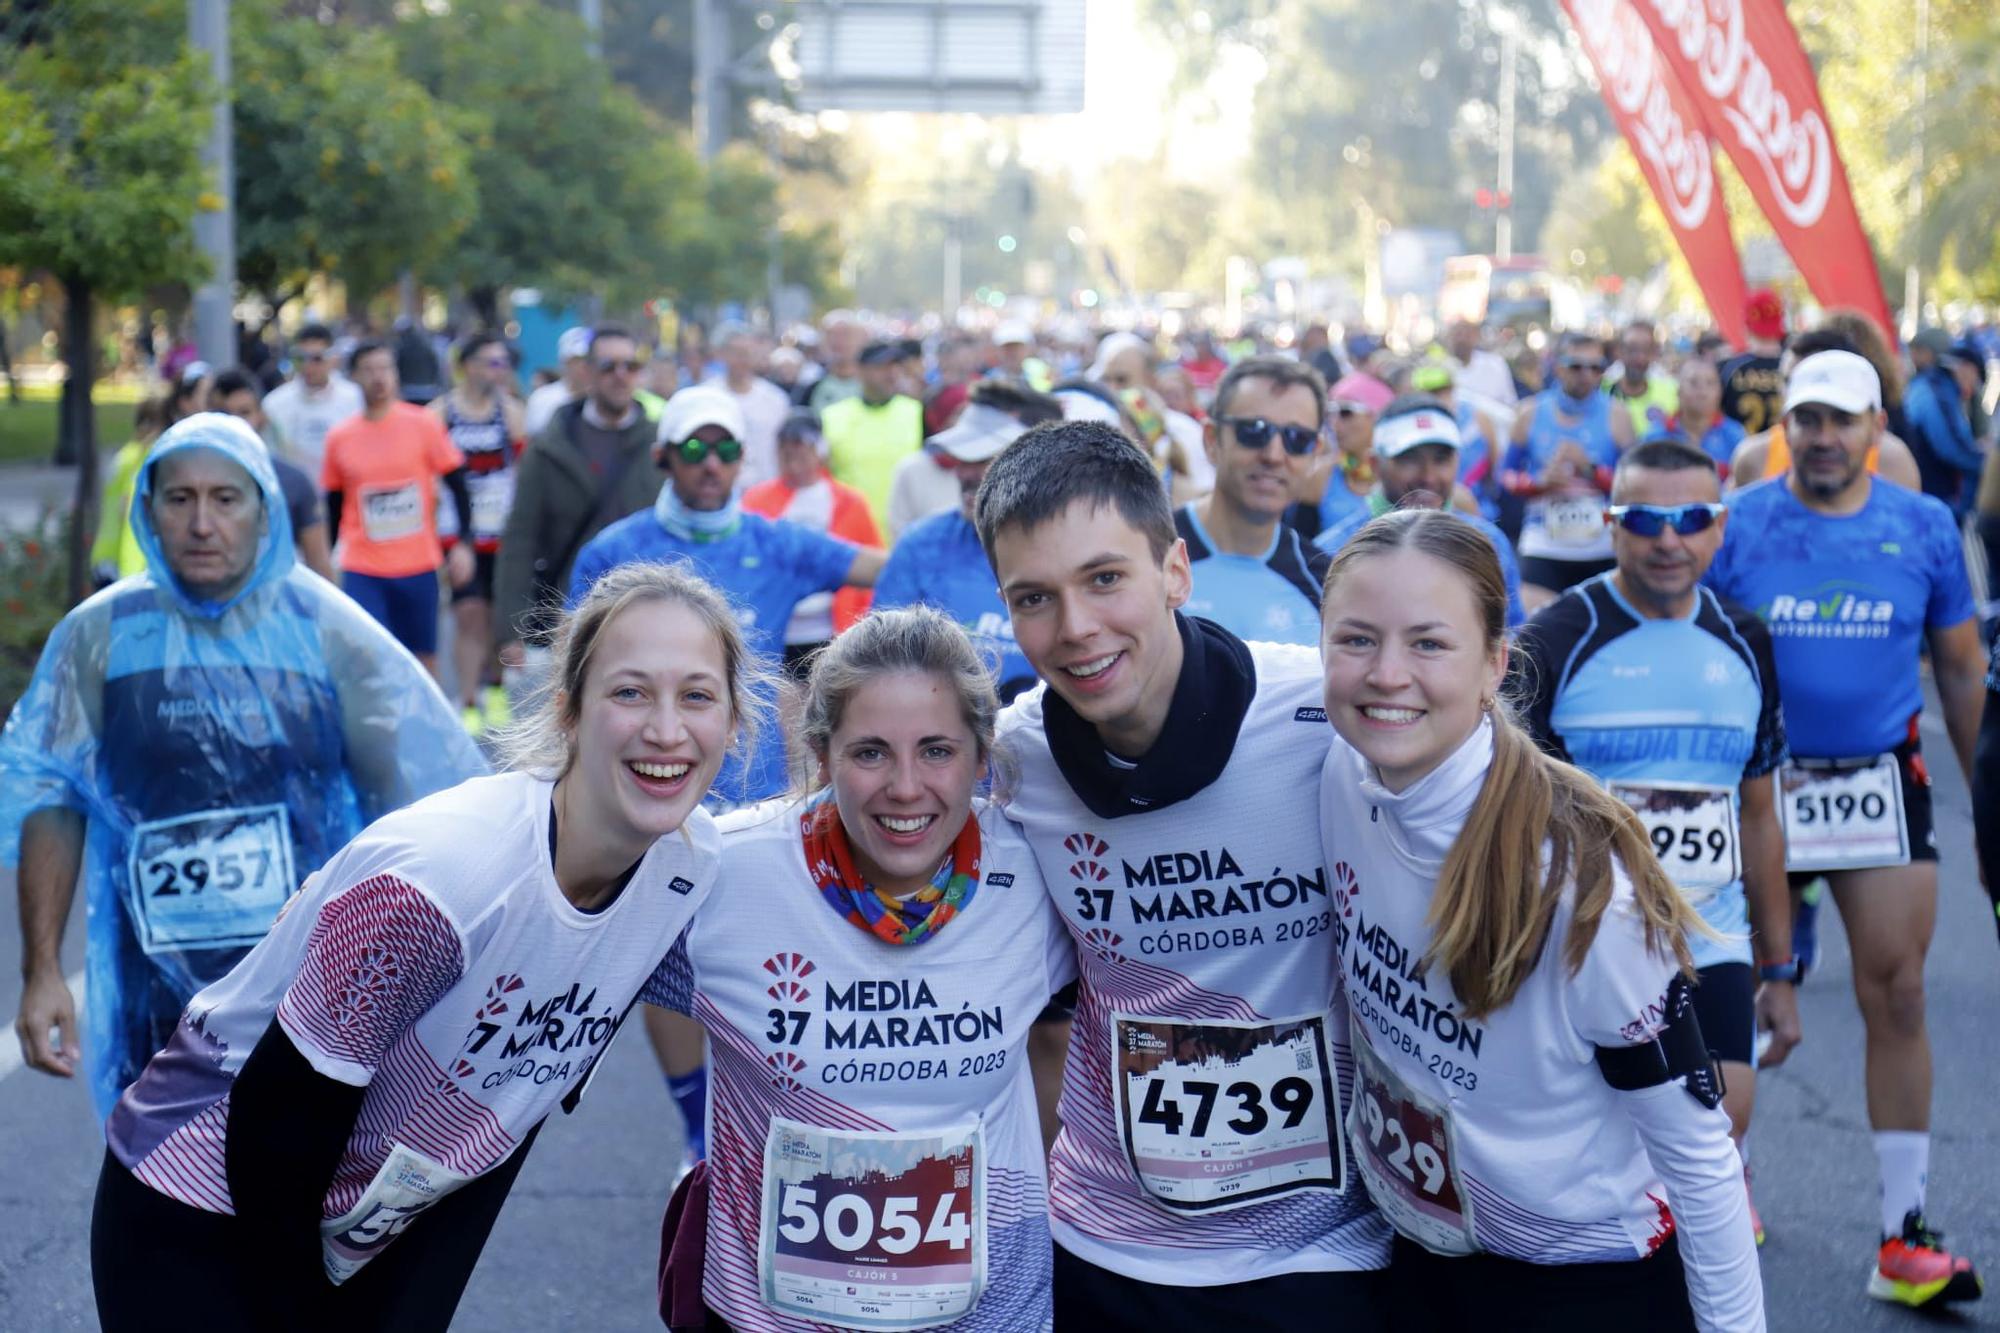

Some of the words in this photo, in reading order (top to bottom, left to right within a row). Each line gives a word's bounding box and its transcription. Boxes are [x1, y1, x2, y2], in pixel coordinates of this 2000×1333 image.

[1586, 727, 1680, 763] MEDIA
[1796, 793, 1885, 824] 5190
[149, 850, 270, 897] 2957
[1121, 846, 1243, 889] MEDIA
[1074, 887, 1114, 922] 37
[1129, 866, 1328, 924] MARATÓN
[1139, 924, 1264, 955] CÓRDOBA
[1276, 911, 1331, 942] 2023
[1356, 910, 1428, 991] MEDIA
[825, 978, 938, 1012] MEDIA
[1352, 946, 1483, 1060] MARATÓN
[766, 1008, 812, 1045] 37
[825, 1001, 1004, 1050] MARATÓN
[1352, 990, 1423, 1063] CÓRDOBA
[1427, 1054, 1478, 1091] 2023
[821, 1058, 948, 1084] CÓRDOBA
[958, 1050, 1006, 1077] 2023
[1138, 1077, 1314, 1139] 4739
[1220, 1183, 1240, 1192] 4739
[778, 1187, 970, 1258] 5054
[796, 1295, 814, 1304] 5054
[860, 1305, 880, 1314] 5054
